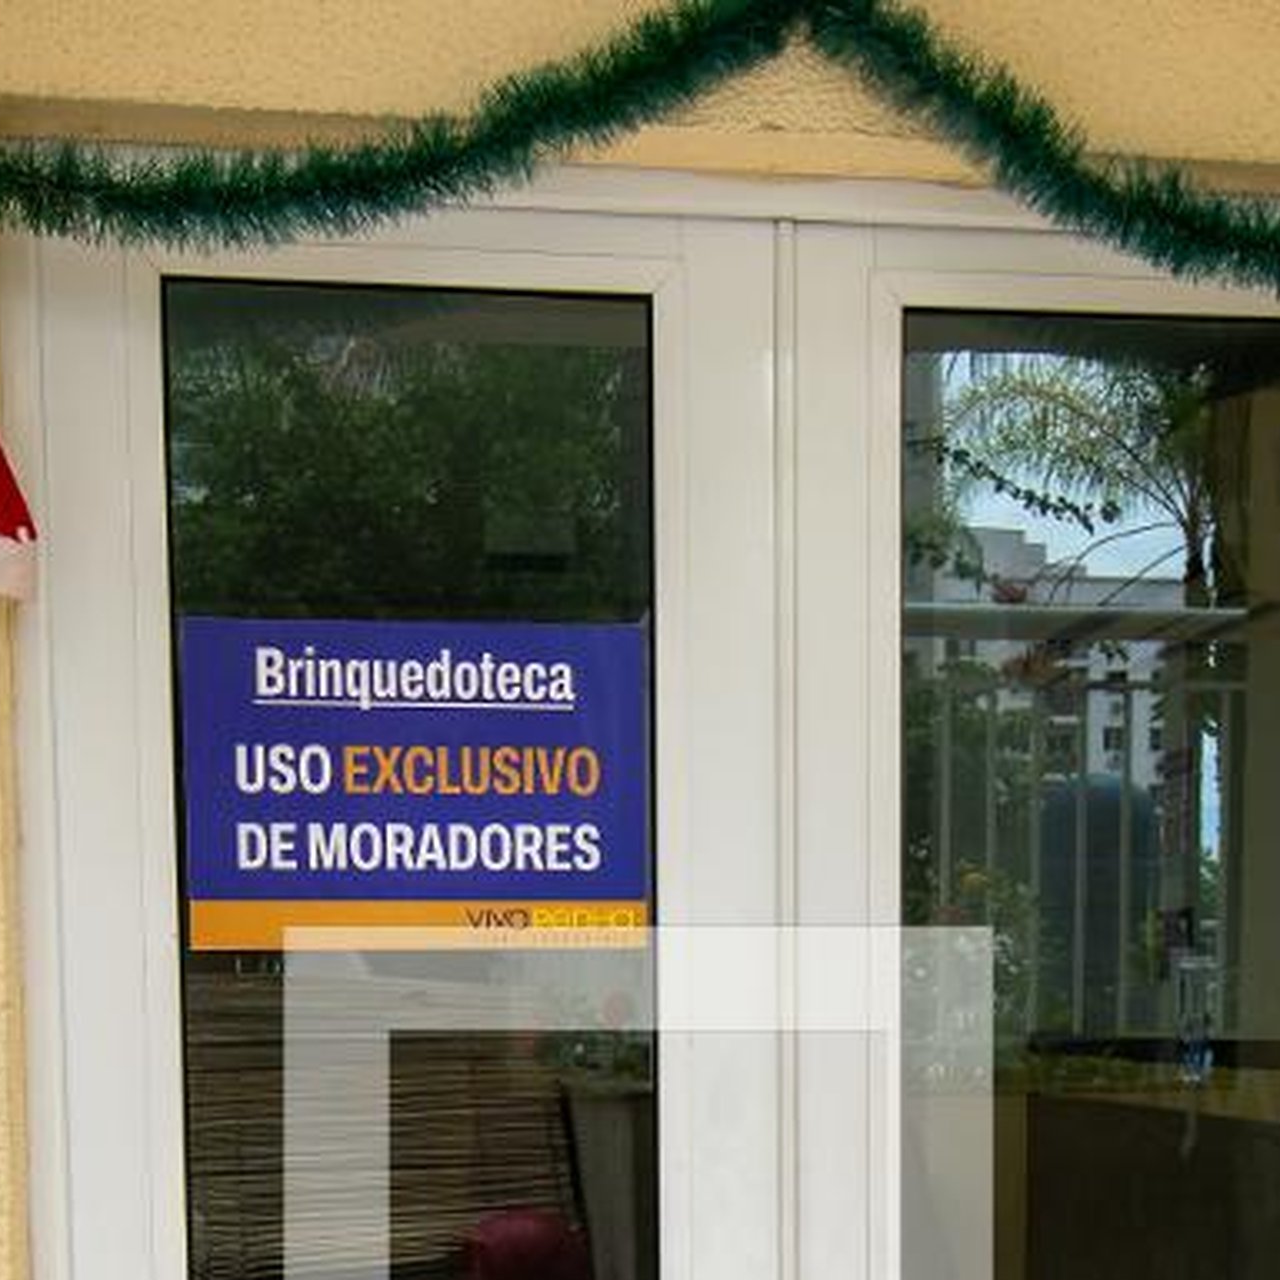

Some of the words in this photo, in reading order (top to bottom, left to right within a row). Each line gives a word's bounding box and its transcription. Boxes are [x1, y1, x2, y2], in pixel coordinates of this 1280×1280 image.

[254, 645, 576, 711] Brinquedoteca
[235, 743, 333, 795] USO
[342, 745, 601, 796] EXCLUSIVO
[236, 822, 297, 871] DE
[308, 822, 601, 872] MORADORES
